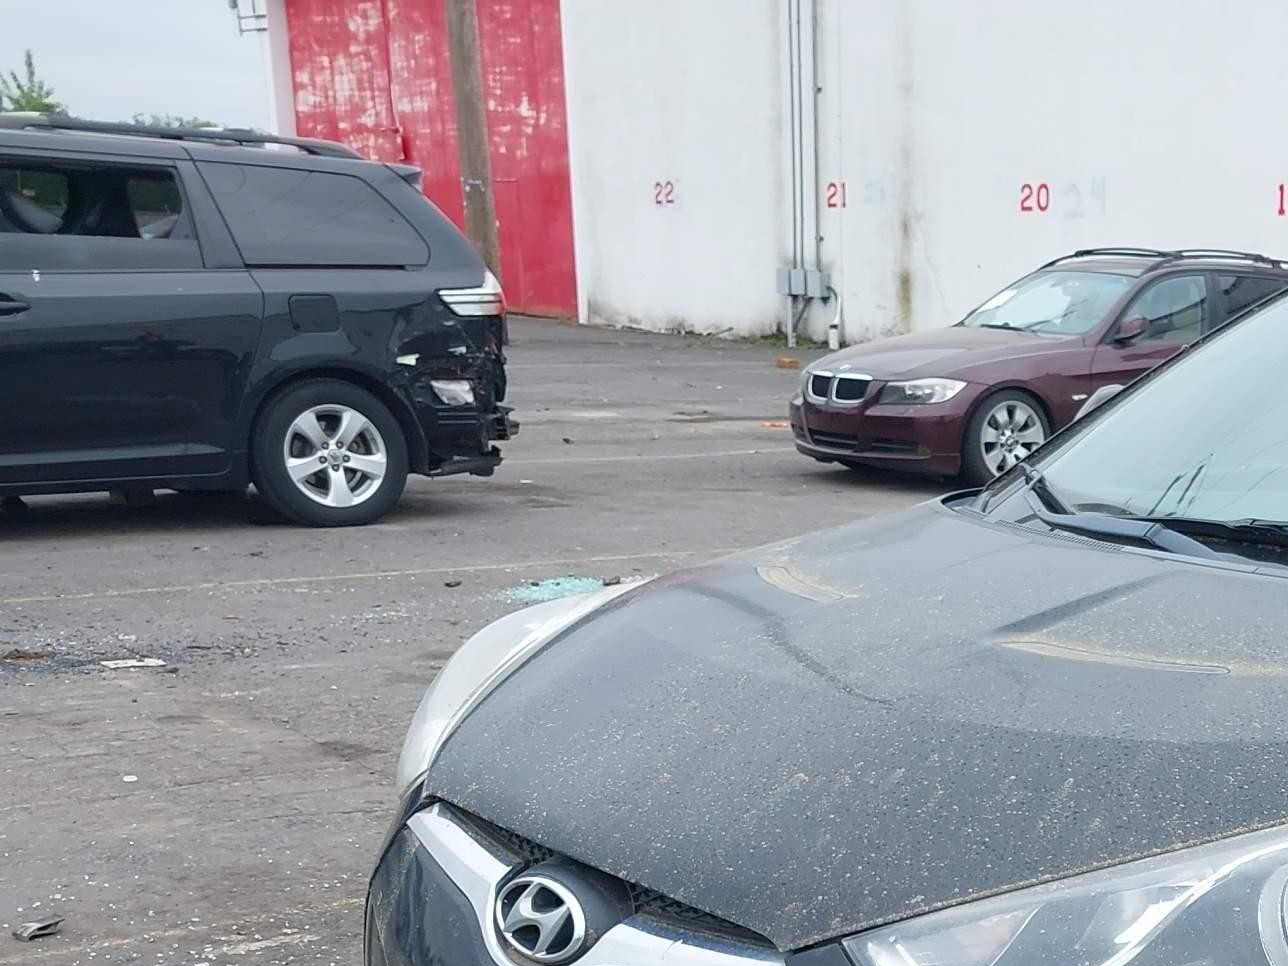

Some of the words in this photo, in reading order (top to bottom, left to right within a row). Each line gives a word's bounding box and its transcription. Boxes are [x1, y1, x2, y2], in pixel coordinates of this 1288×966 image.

[654, 180, 675, 205] 22
[825, 181, 847, 209] 21
[1019, 181, 1051, 213] 20
